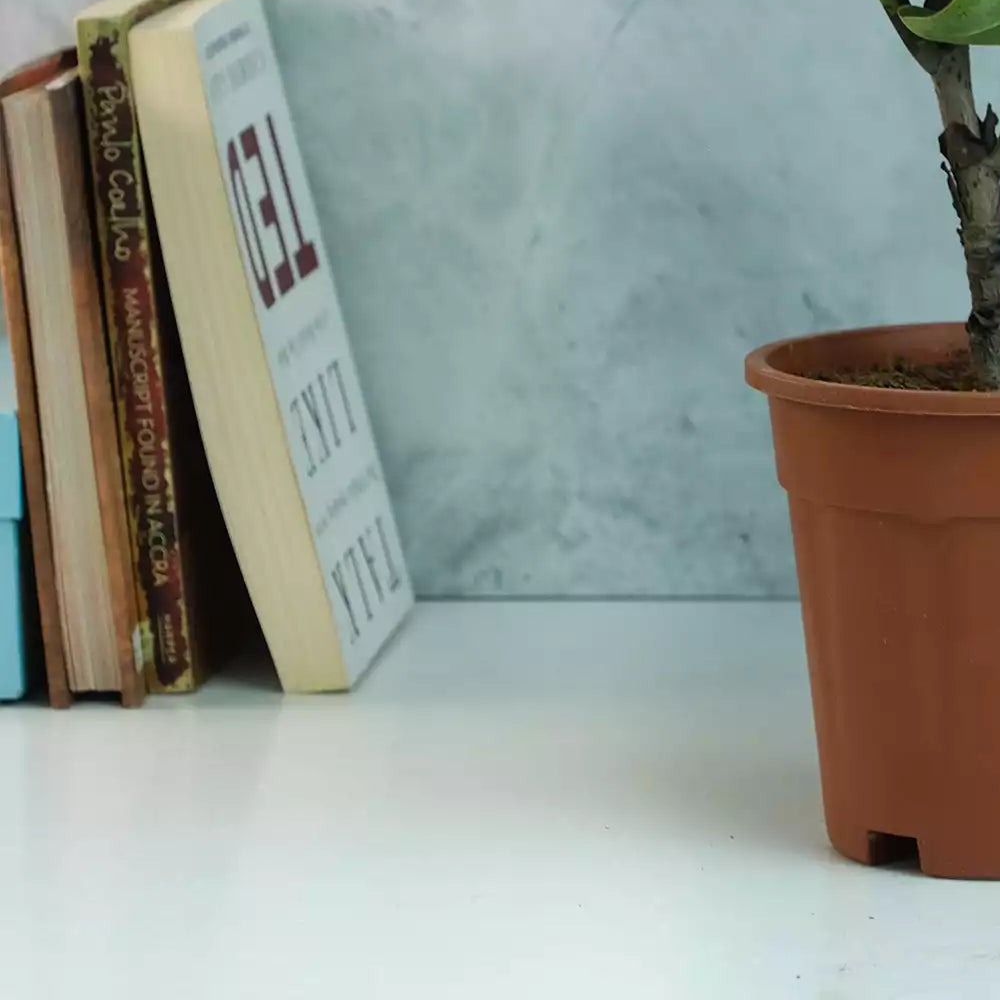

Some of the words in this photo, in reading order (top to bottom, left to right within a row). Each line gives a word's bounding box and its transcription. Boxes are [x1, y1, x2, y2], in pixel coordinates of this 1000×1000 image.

[97, 80, 132, 161] Paulo
[108, 170, 141, 261] Coelho
[227, 111, 319, 310] TED
[122, 286, 152, 414] MANUSCRIPT
[135, 418, 159, 490] FOUND
[289, 360, 357, 478] LIKE
[145, 494, 162, 514] IN
[146, 517, 169, 586] ACCRA
[331, 516, 399, 645] TALK
